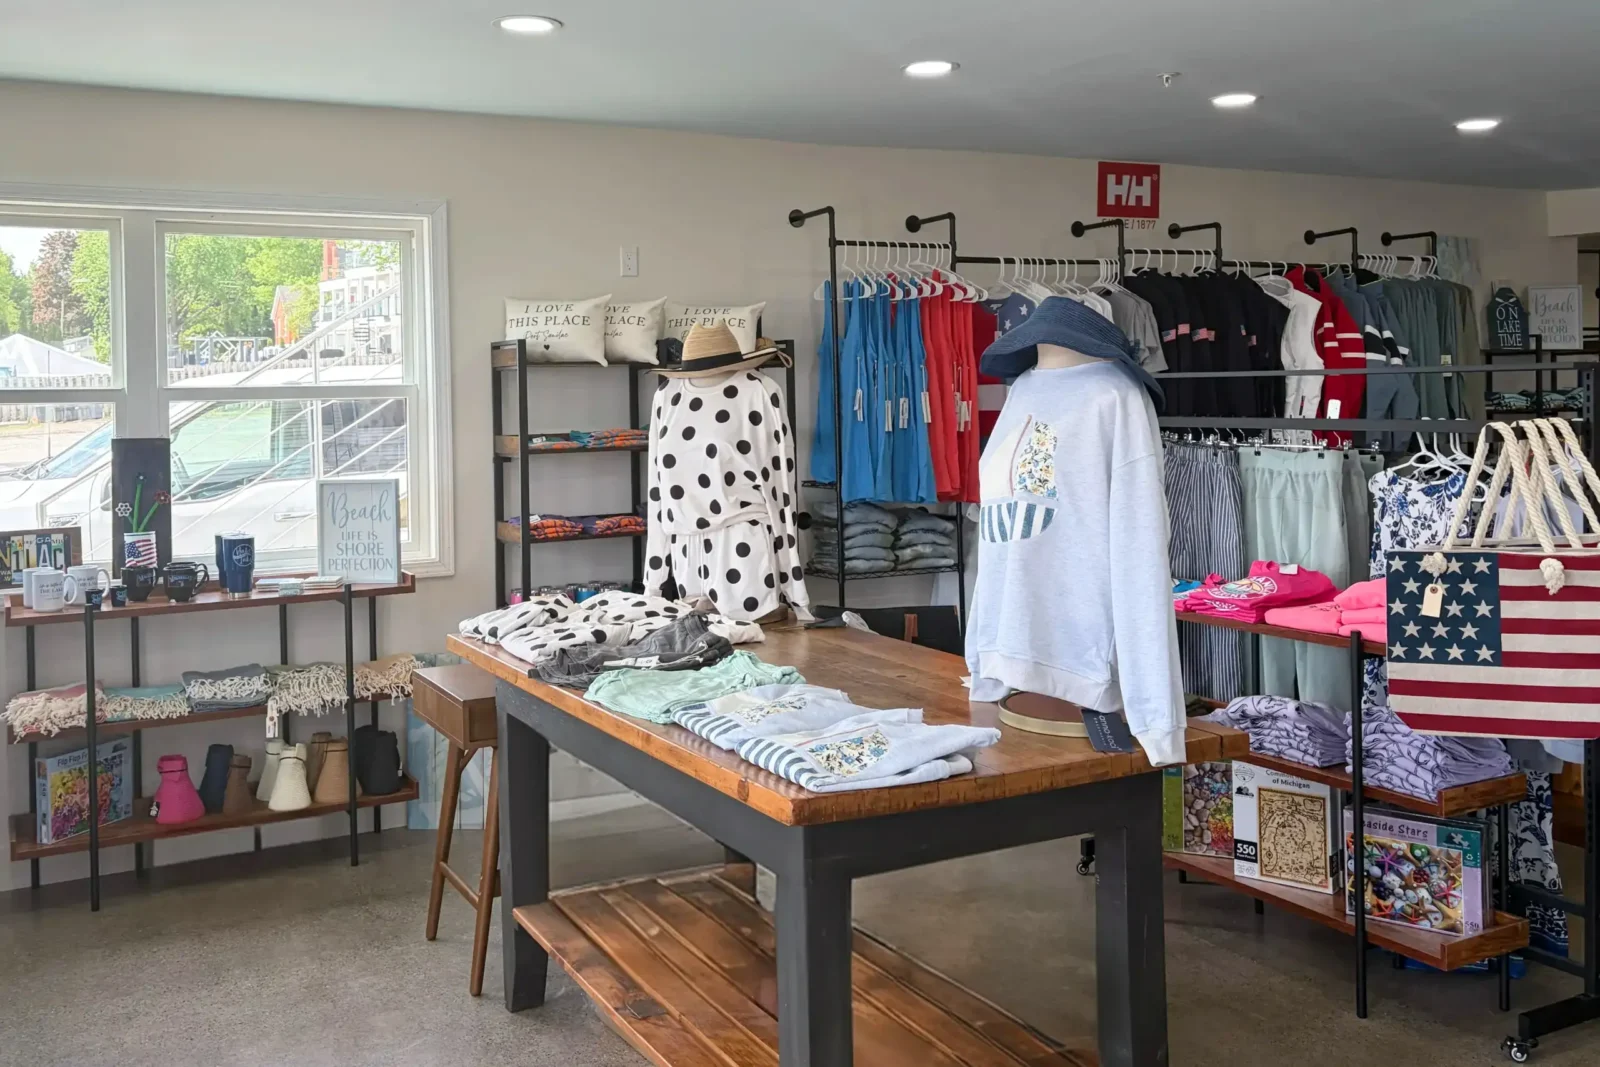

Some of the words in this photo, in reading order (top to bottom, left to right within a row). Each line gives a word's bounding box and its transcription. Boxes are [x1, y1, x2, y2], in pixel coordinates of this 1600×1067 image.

[524, 305, 530, 313] I
[535, 303, 574, 313] LOVE
[605, 305, 631, 313] OVE
[1532, 292, 1575, 317] Beach
[1496, 306, 1519, 320] ON
[509, 316, 539, 329] THIS
[544, 314, 591, 326] PLACE
[668, 317, 697, 328] THIS
[702, 317, 746, 328] PLCE
[1497, 320, 1521, 333] LAKE
[1498, 333, 1523, 347] TIME
[327, 489, 392, 529] Beach
[341, 531, 363, 541] LIFE
[368, 531, 378, 541] IS
[336, 542, 385, 557] SHORE
[328, 558, 393, 571] PERFECTION
[1280, 779, 1311, 789] Michigan
[1362, 820, 1395, 832] aside
[1398, 824, 1428, 838] Stars
[1236, 843, 1256, 856] 550
